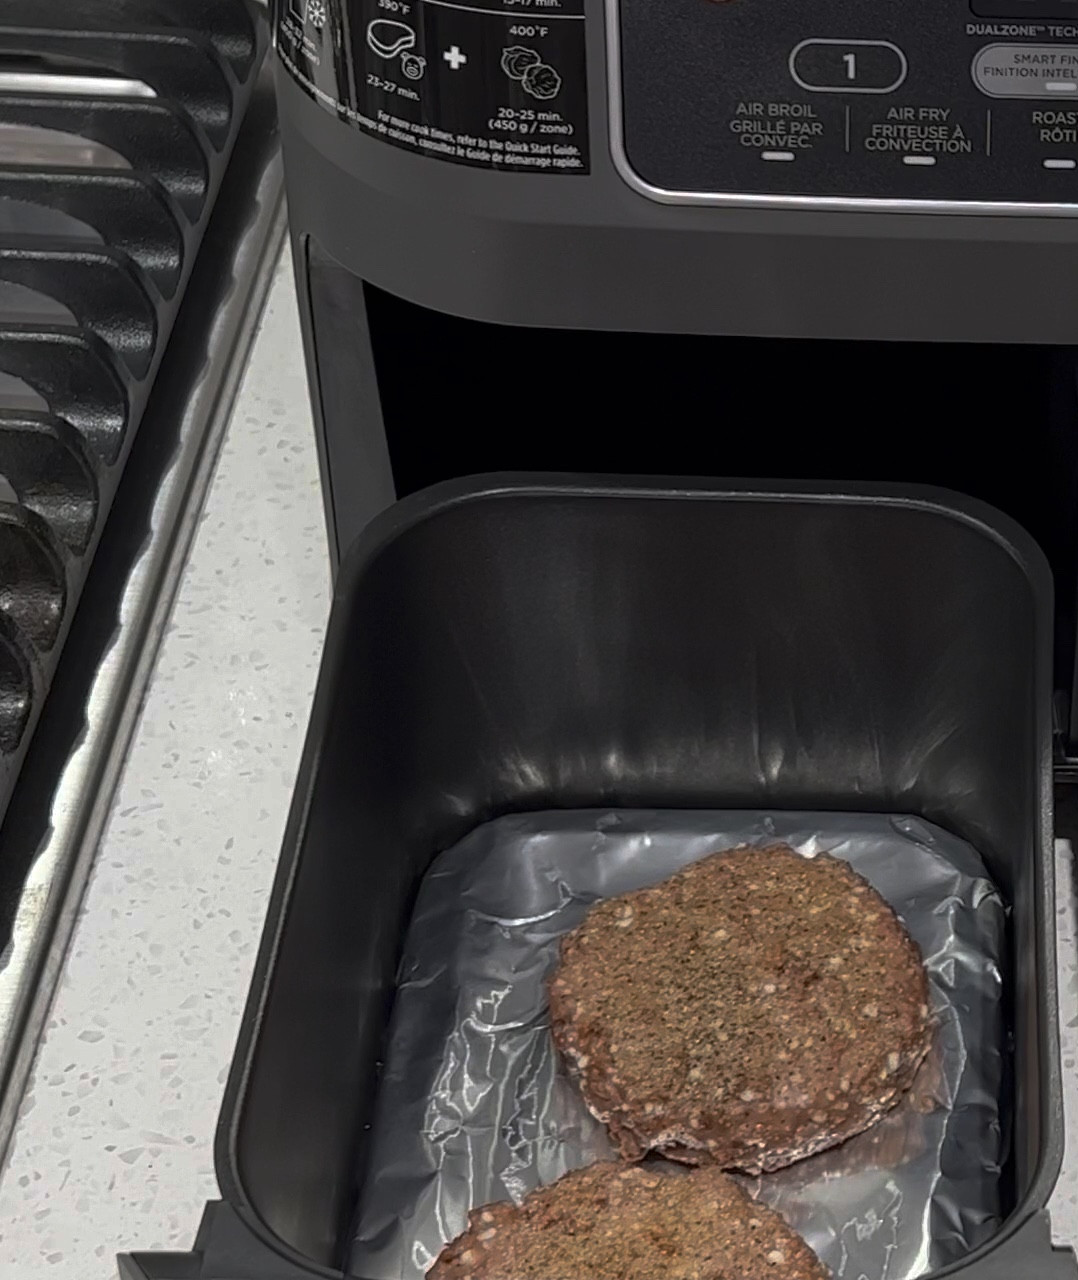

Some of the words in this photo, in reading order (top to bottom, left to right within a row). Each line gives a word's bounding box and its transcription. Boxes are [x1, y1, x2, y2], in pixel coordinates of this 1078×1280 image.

[843, 53, 856, 79] 1
[1014, 54, 1057, 65] SMART
[983, 67, 1040, 78] FINITION
[367, 74, 397, 93] 23-27
[397, 88, 421, 101] min.
[498, 108, 535, 120] 20-25
[538, 111, 563, 121] min.
[736, 103, 765, 116] AIR
[768, 103, 816, 117] BROIL
[887, 108, 915, 120] AIR
[919, 108, 950, 121] FRY
[488, 119, 517, 131] (450
[519, 123, 528, 134] g
[539, 124, 574, 136] zone)
[730, 120, 786, 134] GRILLÉ
[791, 122, 823, 135] PAR
[872, 125, 948, 138] FRITEUSE
[952, 125, 965, 139] À
[1040, 127, 1077, 142] RÔTI
[456, 135, 477, 146] refer
[477, 137, 488, 149] to
[489, 139, 504, 150] the
[505, 140, 529, 153] Quick
[530, 142, 552, 154] Start
[552, 144, 581, 156] Guide.
[740, 134, 812, 148] CONVEC.
[865, 138, 971, 152] CONVECTION
[466, 147, 491, 161] Guide
[491, 152, 503, 163] de
[552, 156, 584, 169] rapide.
